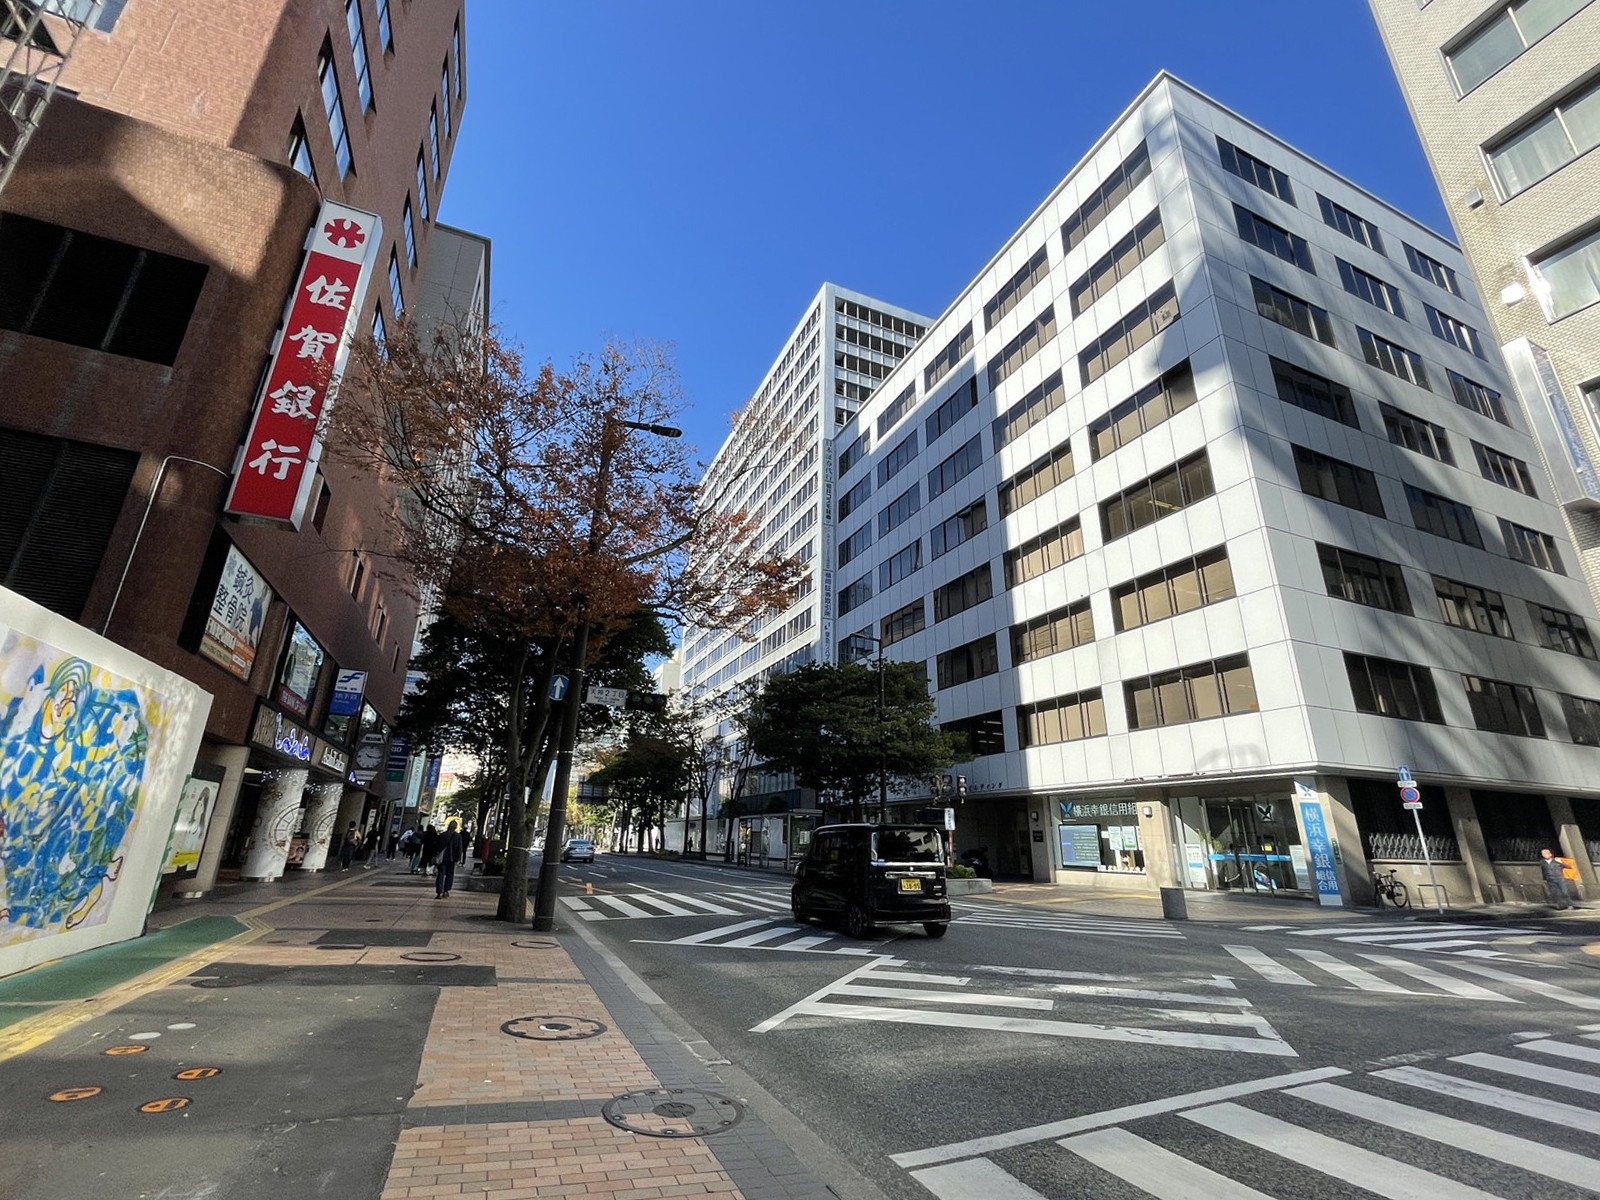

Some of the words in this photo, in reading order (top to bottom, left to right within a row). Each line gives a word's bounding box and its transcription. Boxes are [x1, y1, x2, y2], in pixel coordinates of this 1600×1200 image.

[249, 274, 350, 481] 佐賀銀行
[213, 583, 248, 632] 整骨院
